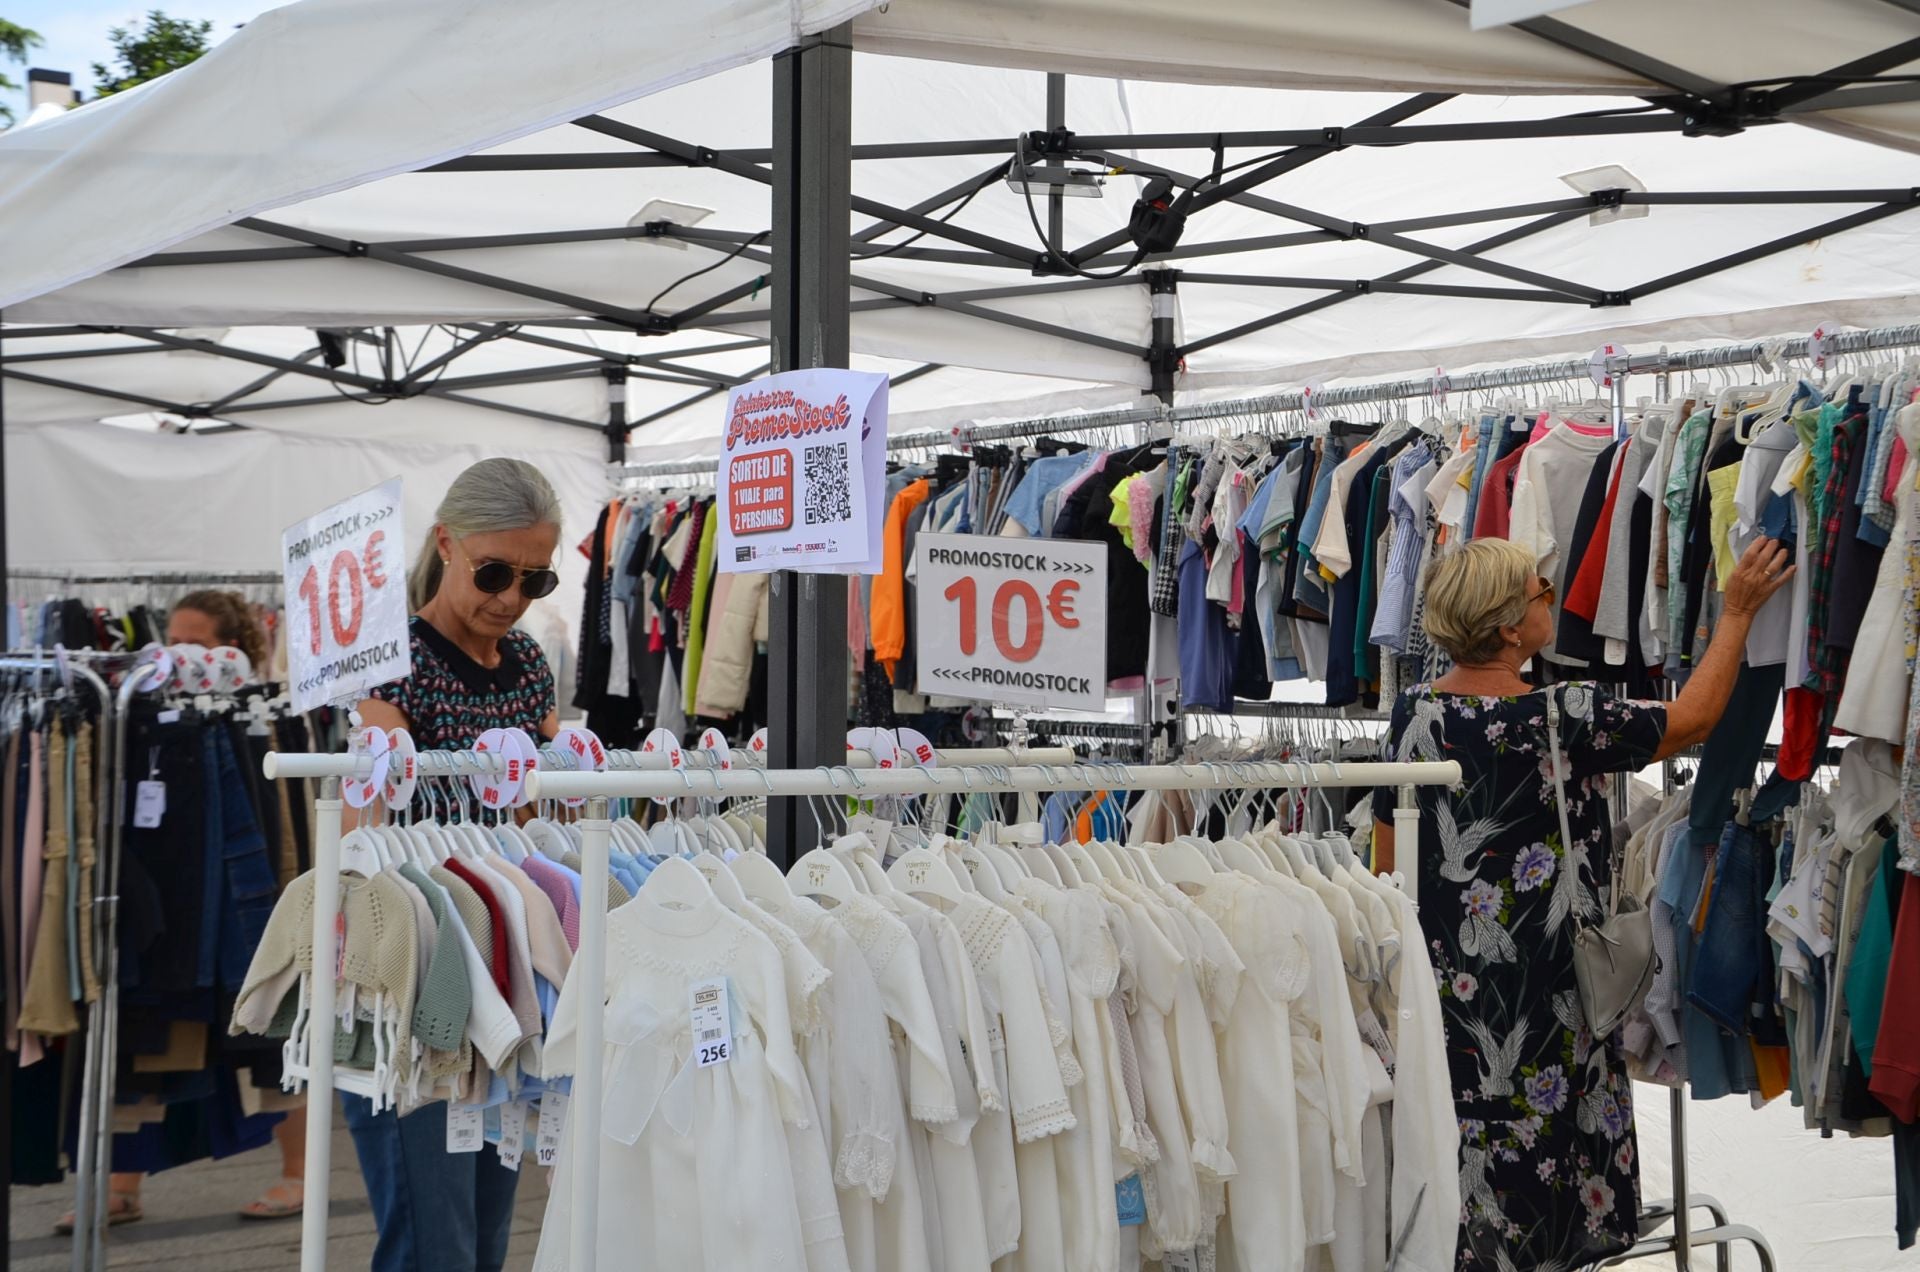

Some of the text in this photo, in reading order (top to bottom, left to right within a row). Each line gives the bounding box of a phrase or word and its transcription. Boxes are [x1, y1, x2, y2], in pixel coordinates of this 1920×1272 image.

[727, 393, 852, 451] PromoStock
[731, 454, 787, 484] SORTEO DE
[734, 486, 784, 506] 1 VIAJE para
[734, 507, 785, 531] 2 PERSONAS
[288, 513, 362, 563] PROMOSTOCK
[928, 548, 1047, 572] PROMOSTOCK
[299, 530, 388, 657] 10€
[944, 576, 1081, 664] 10€
[319, 639, 400, 686] PROMOSTOCK
[970, 667, 1091, 694] PROMOSTOCK
[568, 733, 586, 758] 12M
[915, 744, 932, 763] 8A
[670, 749, 681, 768] 2A
[700, 1043, 728, 1064] 25€
[539, 1148, 556, 1161] 10€
